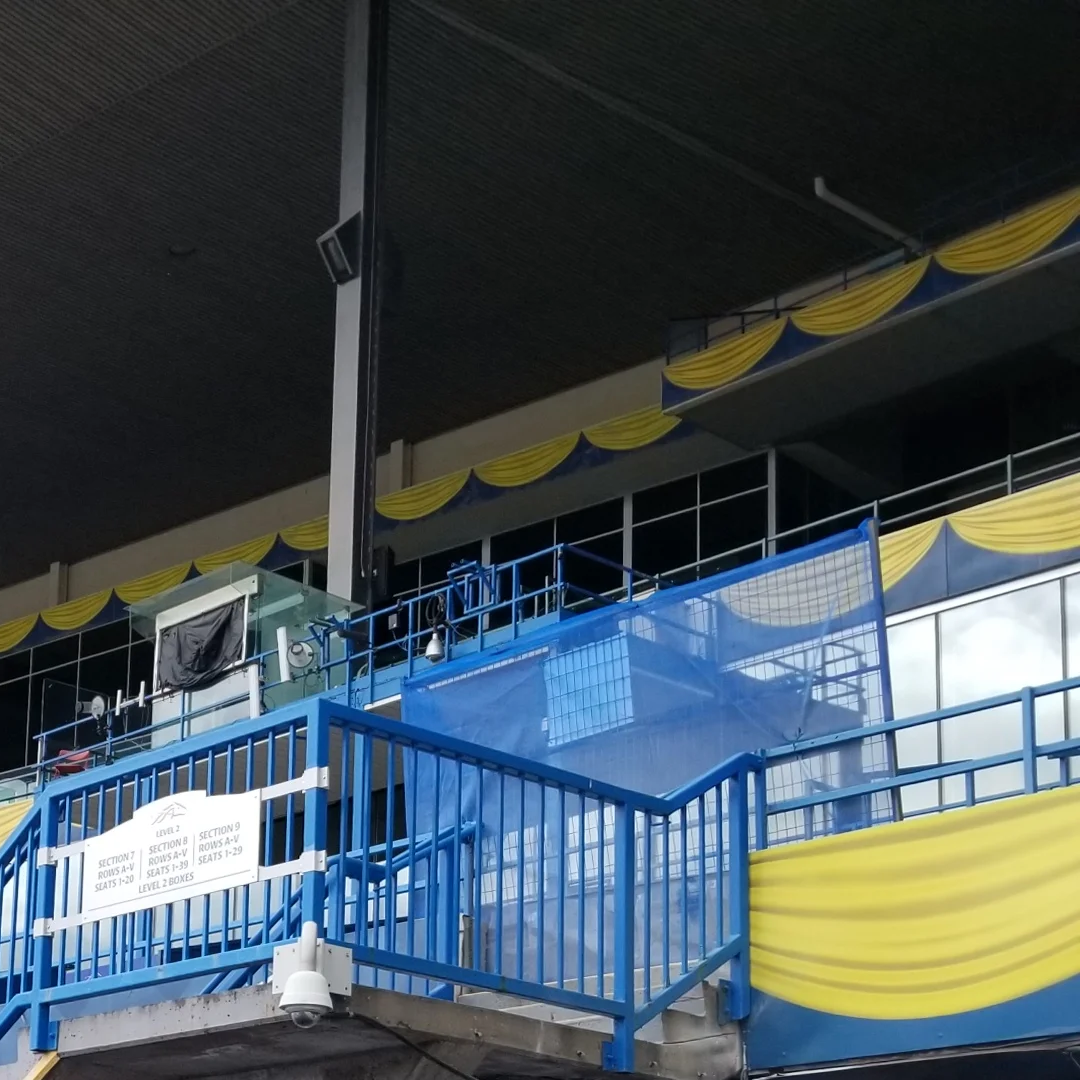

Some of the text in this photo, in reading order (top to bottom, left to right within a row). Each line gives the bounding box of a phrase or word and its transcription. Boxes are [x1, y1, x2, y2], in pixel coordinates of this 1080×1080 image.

[156, 828, 174, 838] LEVEL
[199, 821, 241, 841] SECTION 9
[148, 836, 188, 855] SECTION 8
[198, 839, 223, 853] ROWS
[98, 850, 135, 869] SECTION 7
[148, 852, 172, 867] ROWS
[198, 851, 223, 865] SEATS
[98, 866, 120, 880] ROWS
[146, 865, 170, 879] SEATS
[94, 878, 118, 892] SEATS
[138, 871, 195, 894] LEVEL 2 BOXES
